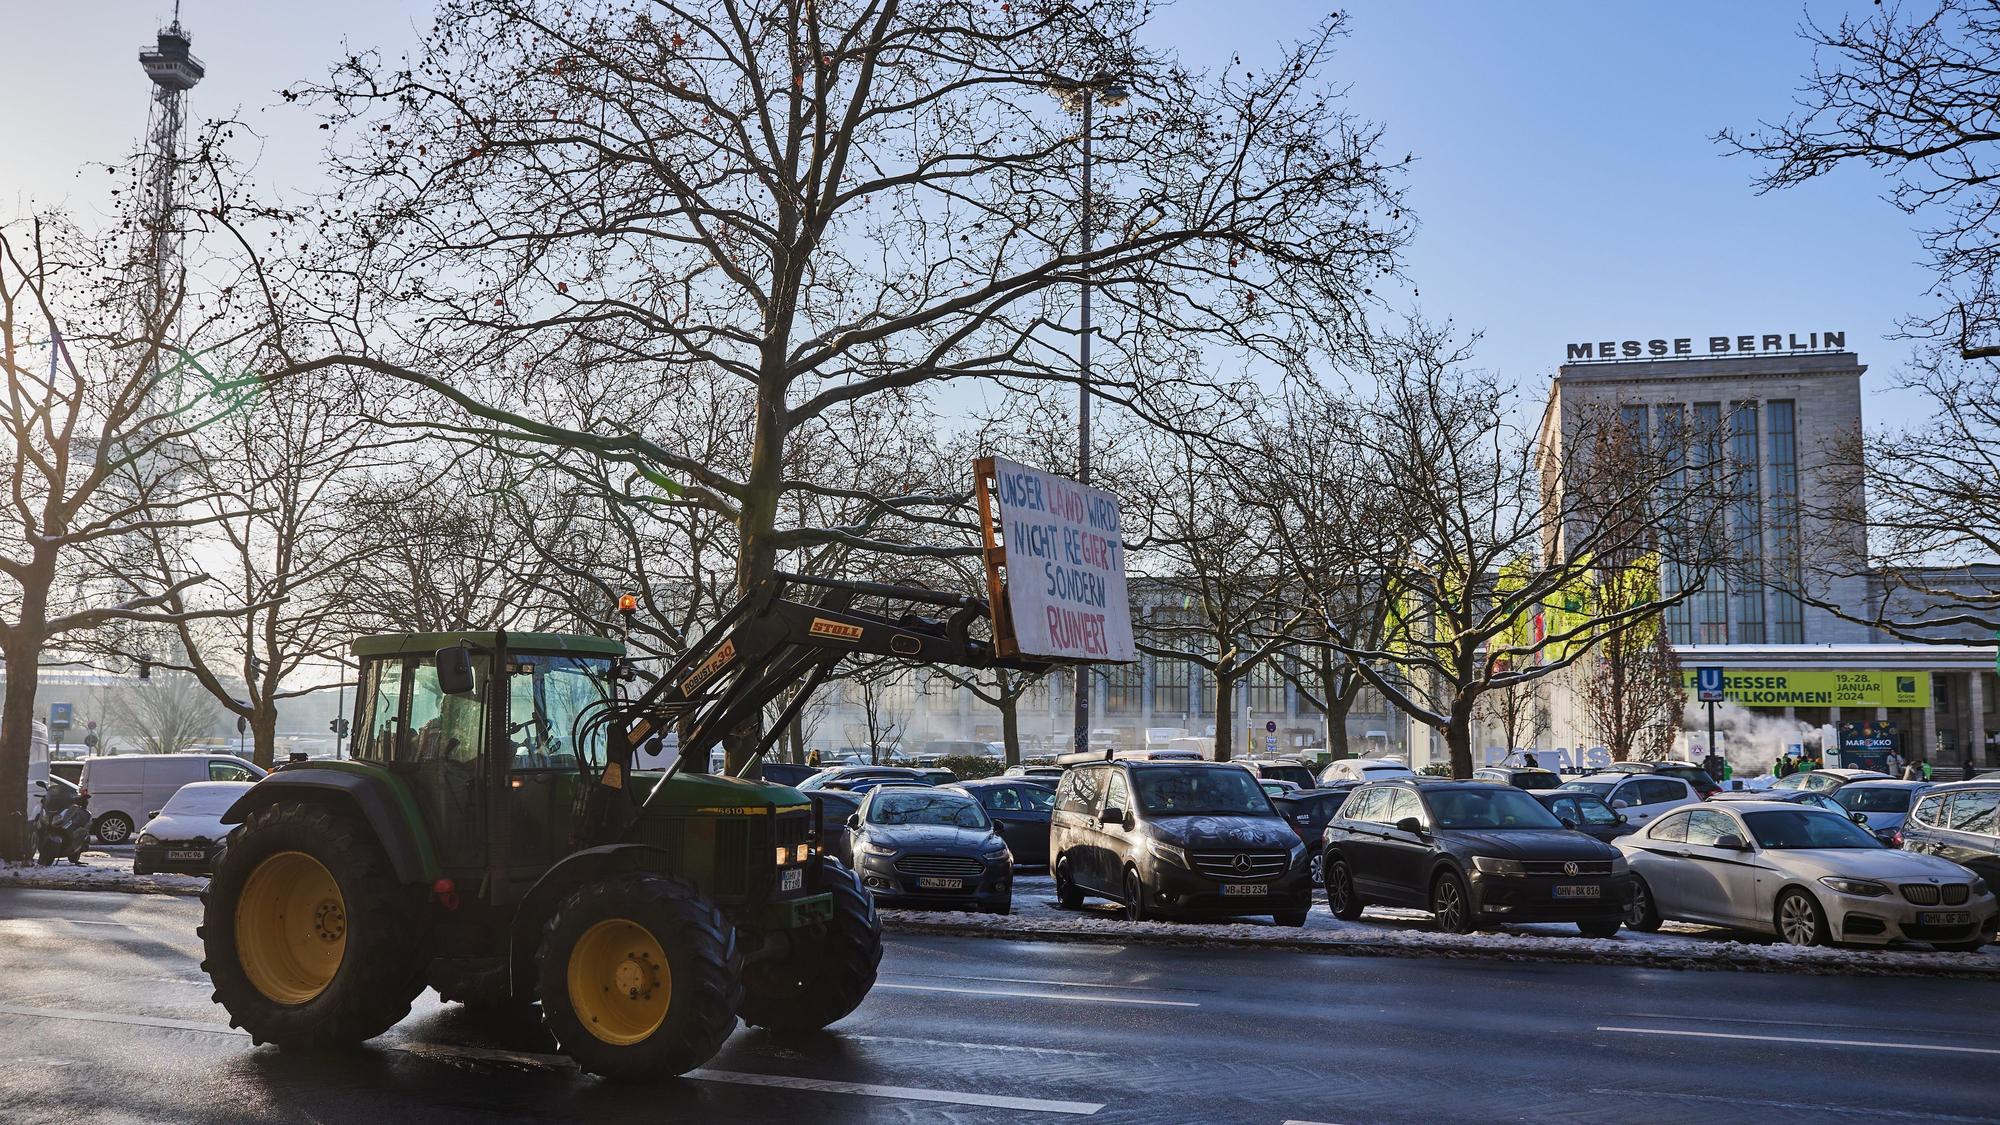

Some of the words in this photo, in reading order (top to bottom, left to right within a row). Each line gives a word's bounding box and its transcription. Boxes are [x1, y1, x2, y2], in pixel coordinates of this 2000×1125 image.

[1567, 338, 1692, 358] MESSE
[1709, 331, 1845, 352] BERLIN
[998, 470, 1045, 511] UNSER
[1046, 480, 1084, 524] LAND
[1085, 494, 1117, 532] WIRD
[1014, 521, 1058, 561] NICHT
[1064, 526, 1118, 571] REGIERT
[1045, 561, 1106, 609] SONDERN
[812, 622, 860, 638] STOLL
[1046, 605, 1108, 655] RUINIERT
[684, 665, 711, 693] ROBUST
[1701, 670, 1719, 690] U
[1836, 674, 1871, 683] 19.-28.
[1837, 683, 1880, 692] JANUAR
[1837, 692, 1864, 701] 2024
[1846, 739, 1892, 747] MAROKKO
[1252, 885, 1267, 895] 234
